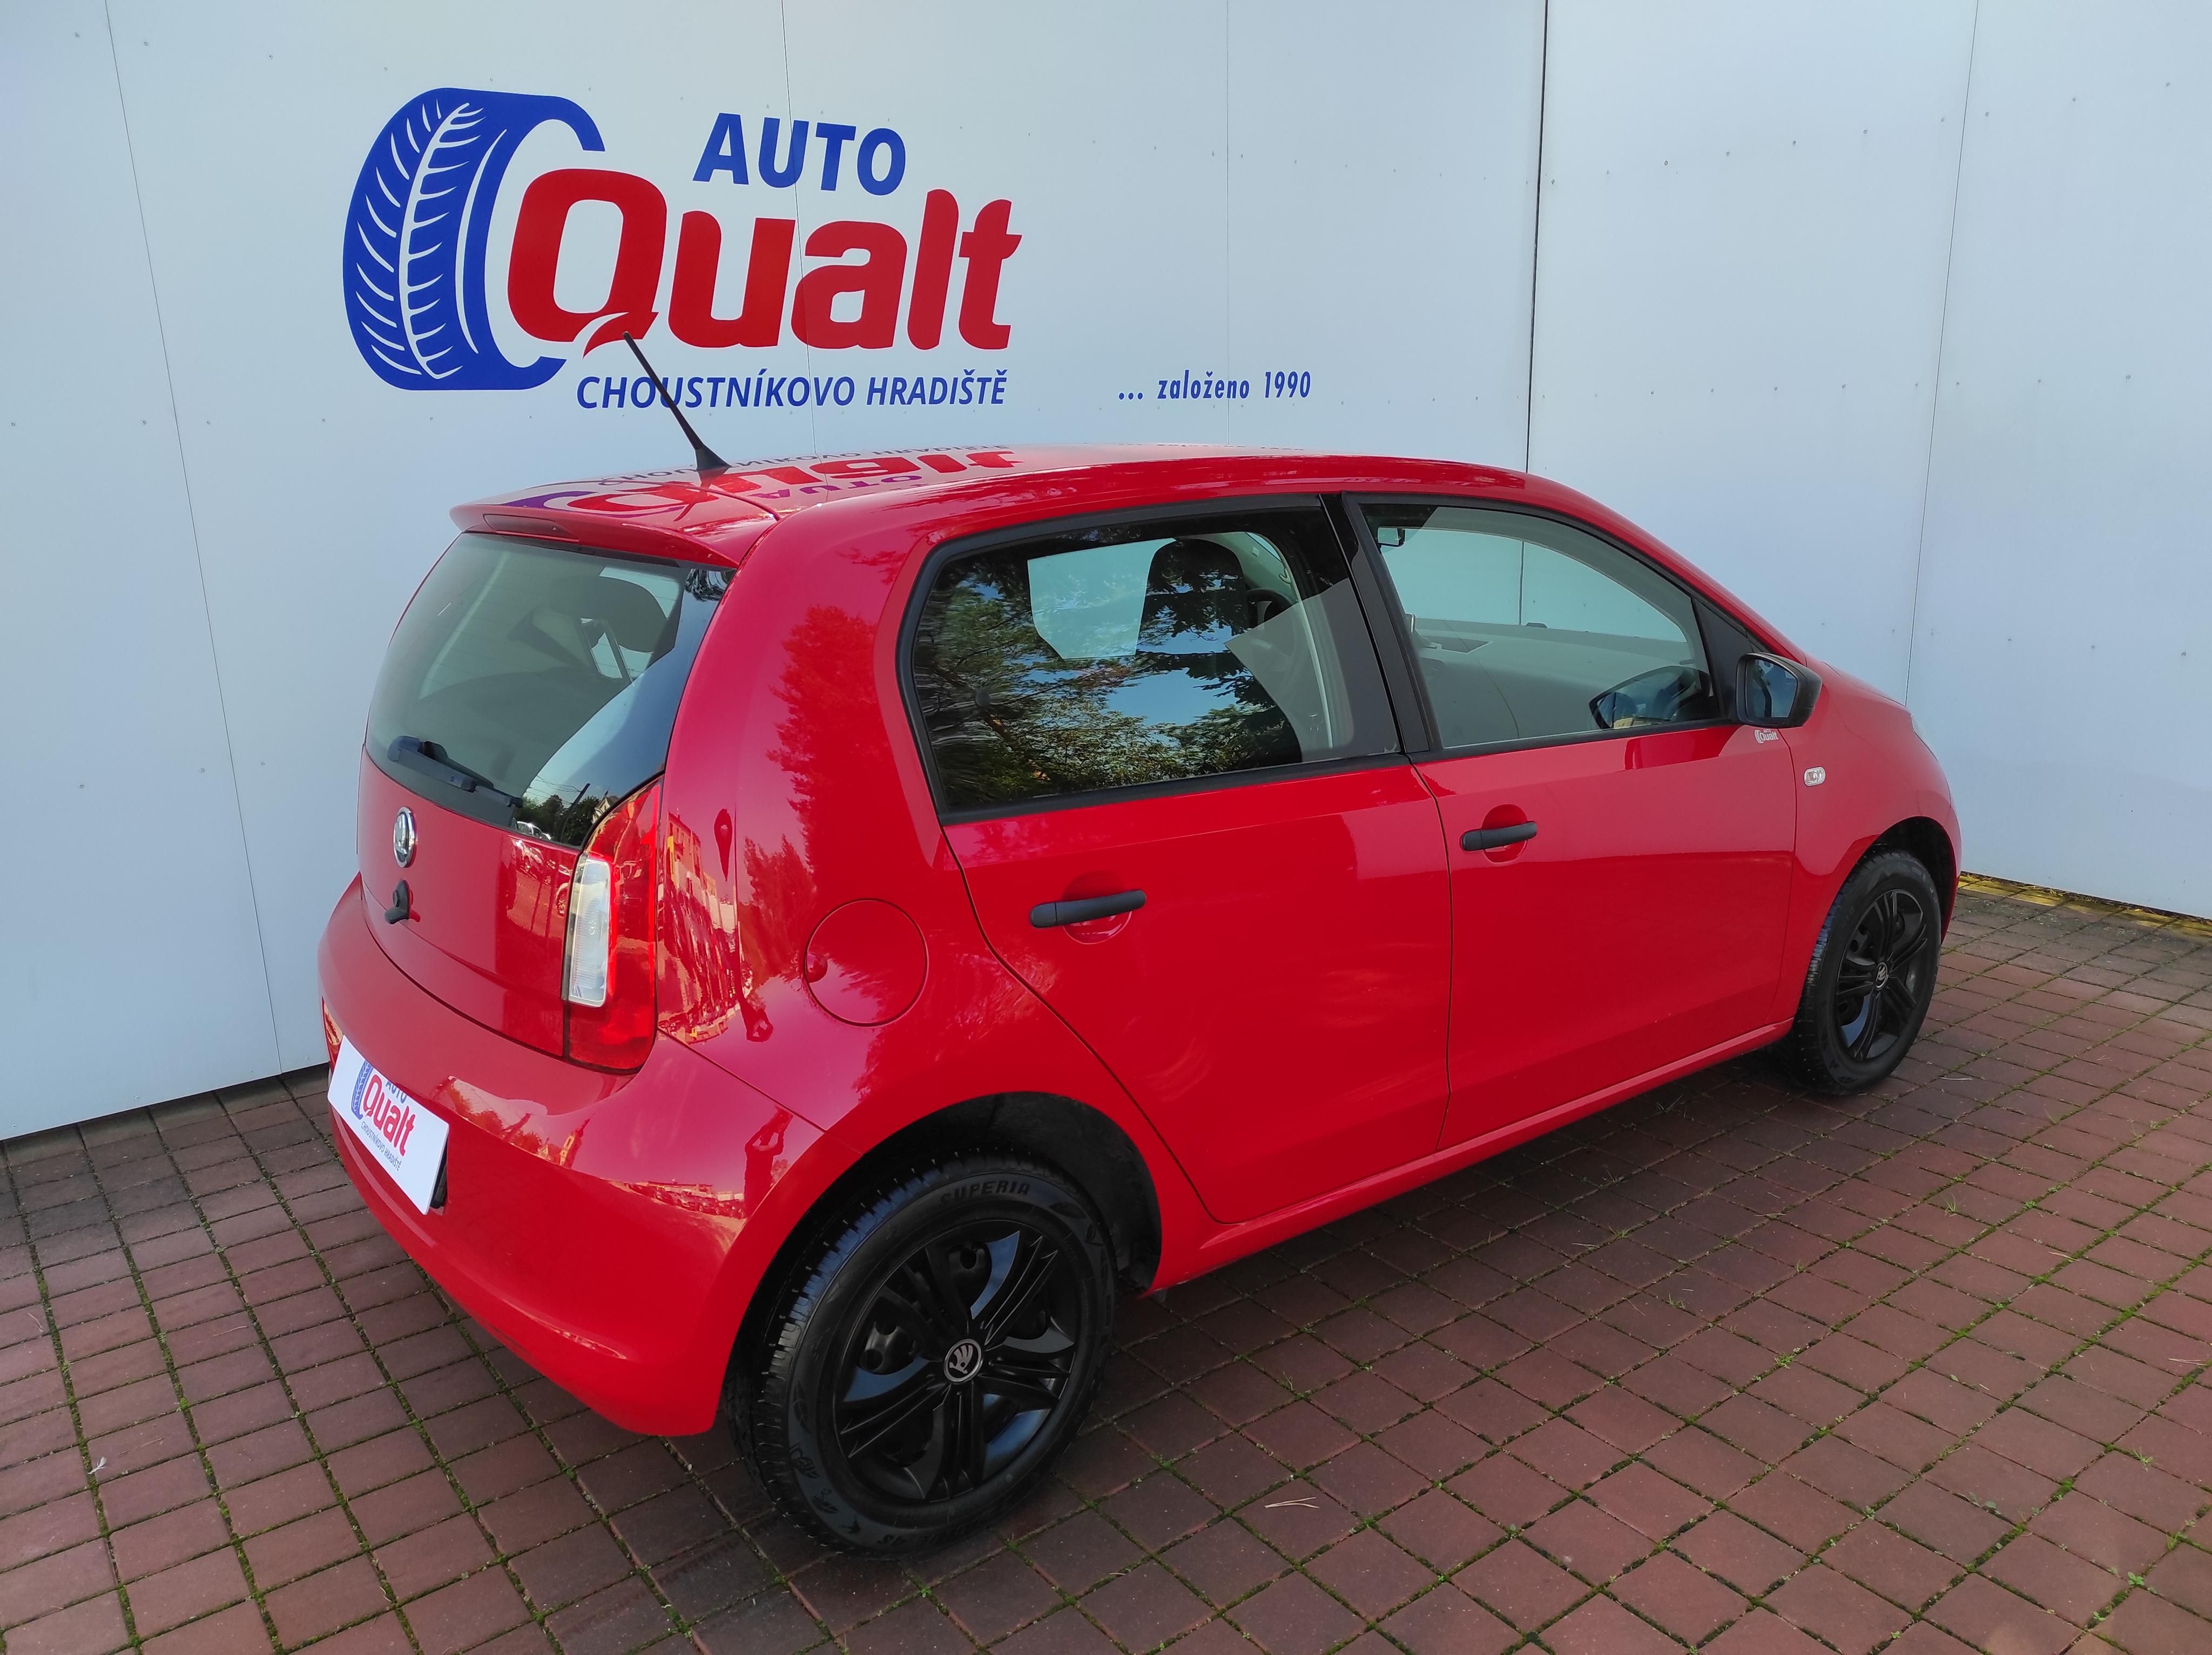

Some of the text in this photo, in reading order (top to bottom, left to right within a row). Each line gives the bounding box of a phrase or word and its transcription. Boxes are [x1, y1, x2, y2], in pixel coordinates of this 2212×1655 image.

[692, 112, 906, 196] AUTO
[508, 169, 1022, 359] Qualt
[576, 368, 1008, 409] CHOUSTNÍKOVO HRADIŠTĚ
[1157, 369, 1250, 400] založeno
[1265, 371, 1312, 398] 1990
[363, 1075, 416, 1157] Qualt
[940, 1180, 1030, 1204] SUPERIA
